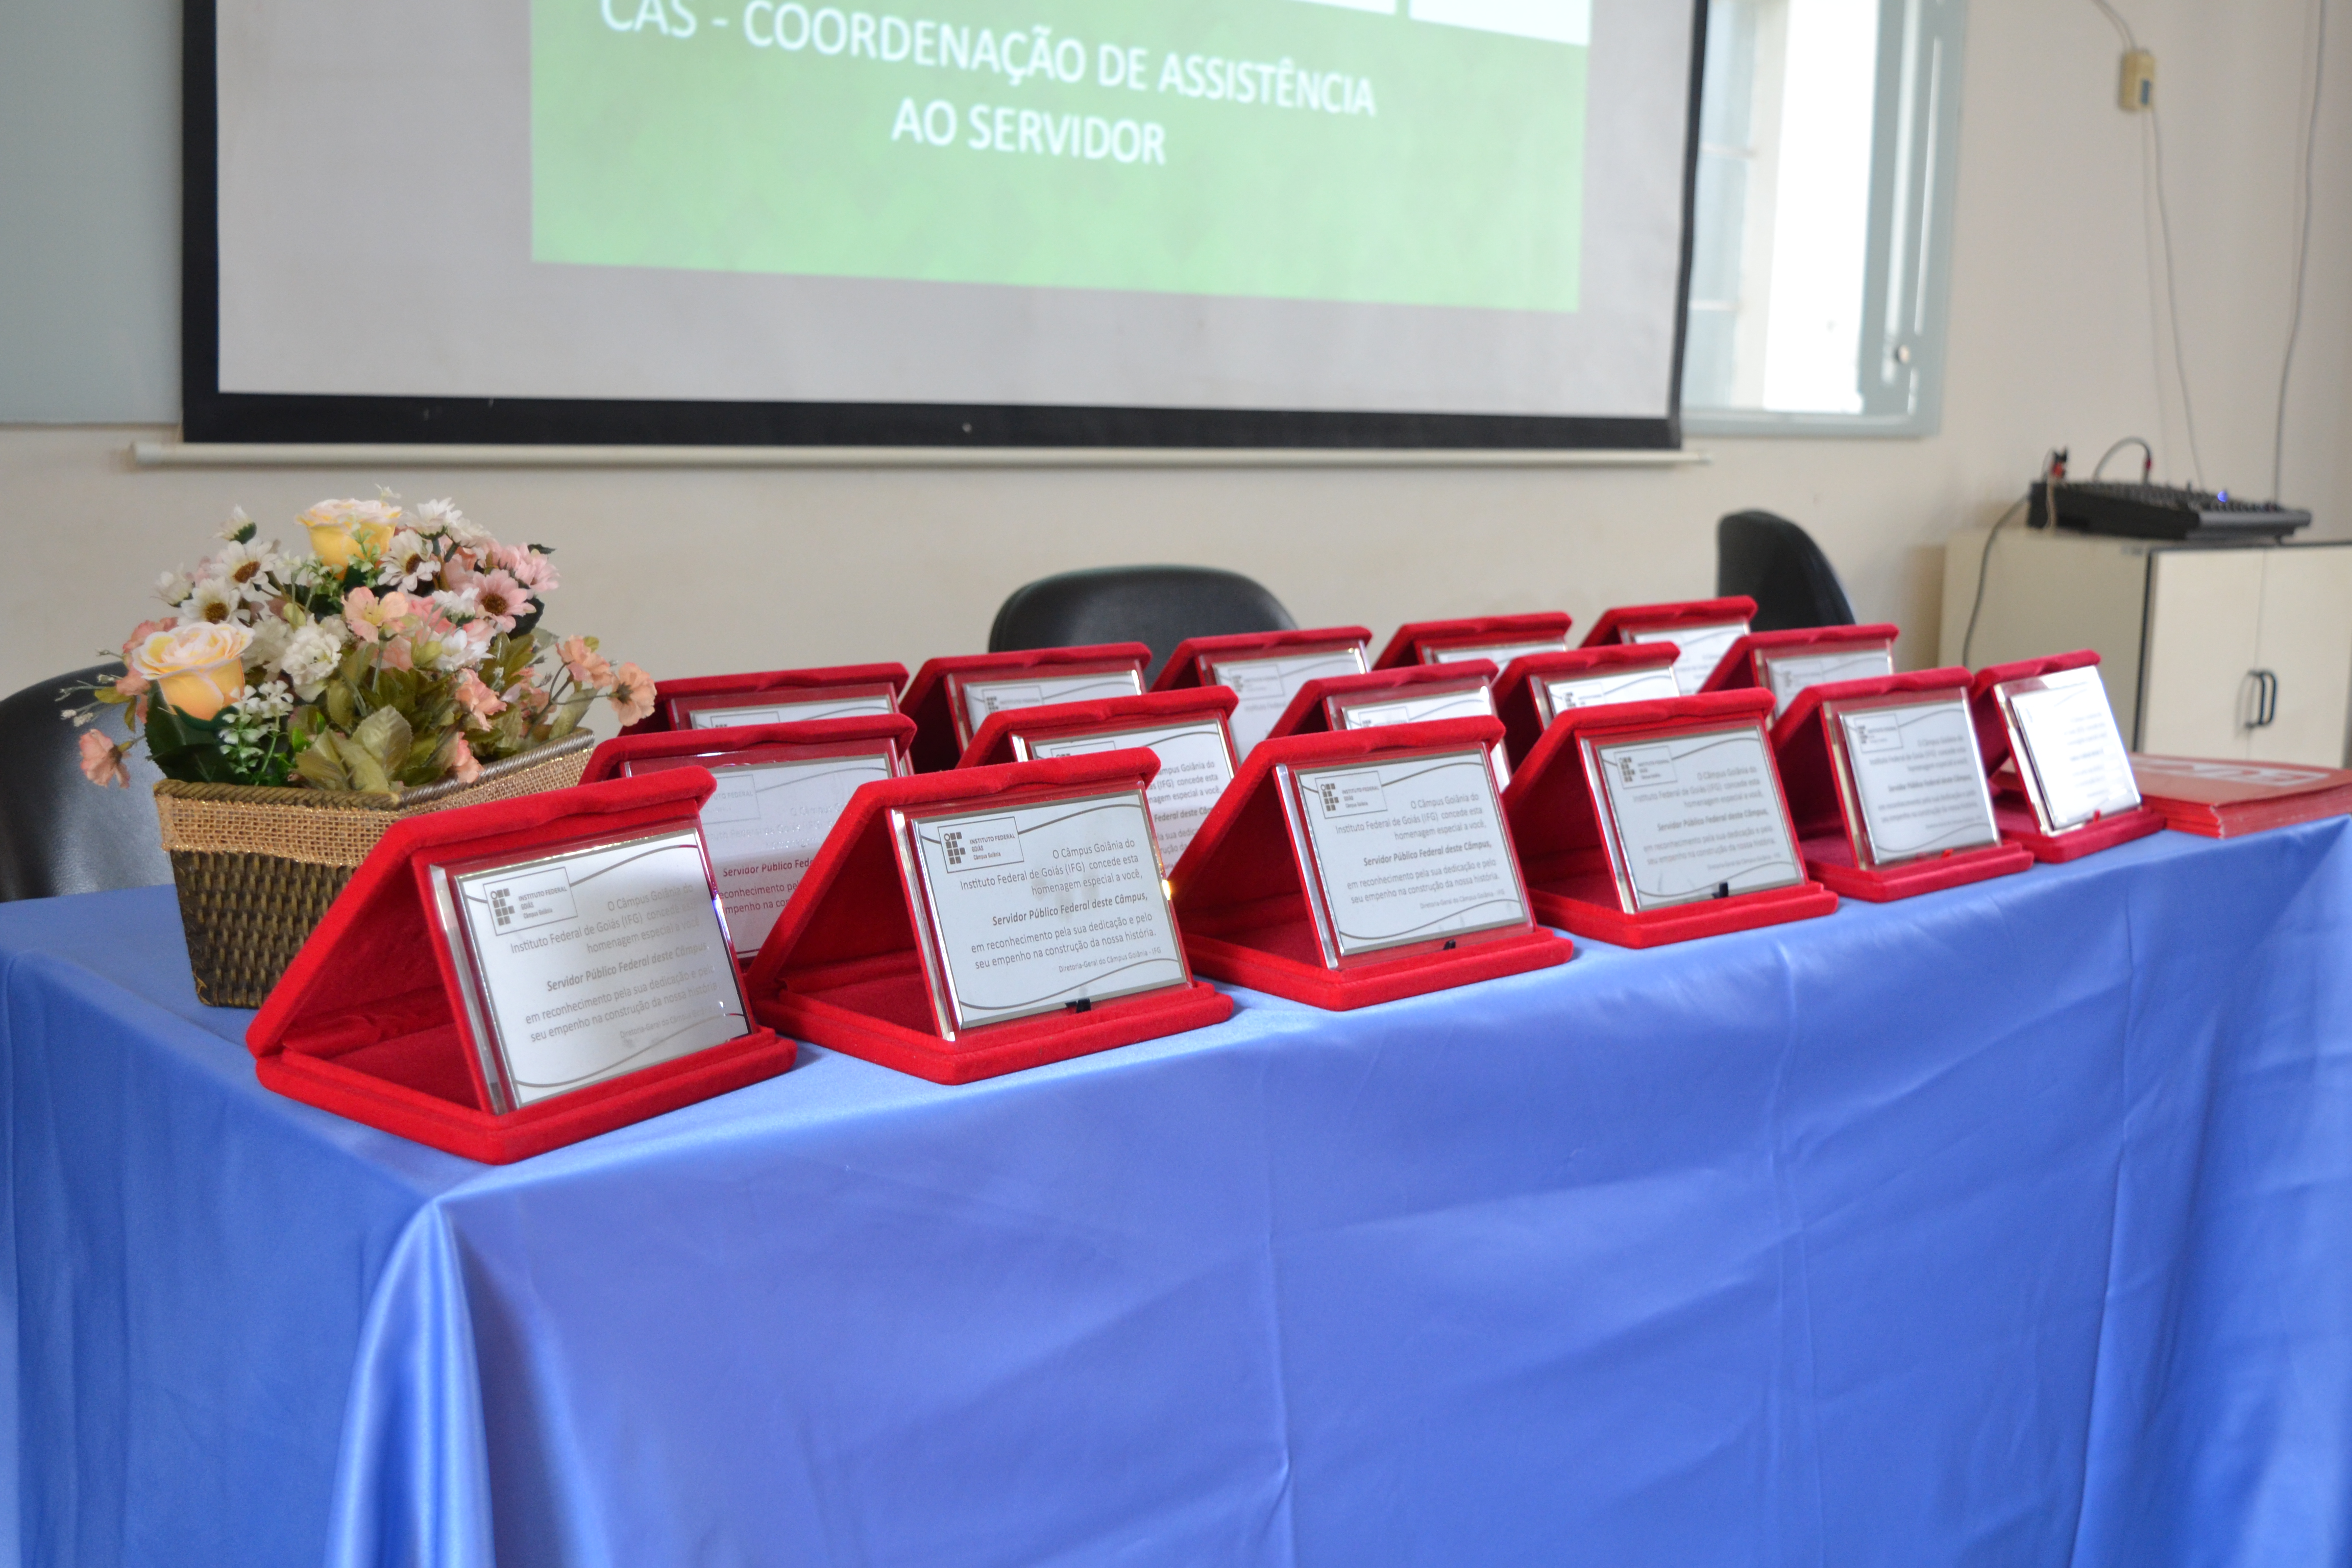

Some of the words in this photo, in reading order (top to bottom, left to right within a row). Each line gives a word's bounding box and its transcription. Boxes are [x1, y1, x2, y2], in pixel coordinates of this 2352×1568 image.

[600, 0, 698, 38] CAS
[712, 17, 729, 27] -
[743, 0, 1086, 86] COORDENAÇÃO
[1097, 44, 1148, 91] DE
[1158, 53, 1376, 117] ASSISTÊNCIA
[891, 97, 957, 145] AO
[967, 104, 1166, 165] SERVIDOR
[1157, 779, 1174, 791] (IFG)
[1177, 775, 1204, 786] concede
[1172, 790, 1198, 801] especial
[1417, 798, 1444, 808] Câmpus
[1444, 793, 1469, 805] Goiânia
[1469, 792, 1479, 801] do
[1154, 812, 1179, 823] Federal
[1180, 808, 1198, 820] deste
[1335, 823, 1365, 834] Instituto
[1365, 817, 1391, 830] Federal
[1391, 817, 1401, 826] de
[1401, 814, 1421, 825] Goiás
[1420, 811, 1438, 824] (IFG)
[1440, 807, 1468, 820] concede
[1468, 806, 1483, 816] esta
[1393, 828, 1436, 841] homenagem
[1436, 822, 1463, 835] especial
[1468, 818, 1486, 829] você,
[969, 836, 994, 844] INSTITUTO
[994, 832, 1016, 841] FEDERAL
[1060, 846, 1093, 858] Câmpus
[1093, 840, 1123, 853] Goiânia
[1124, 838, 1135, 848] do
[1363, 854, 1392, 867] Servidor
[1393, 850, 1418, 862] Público
[1418, 845, 1444, 858] Federal
[1444, 844, 1463, 854] deste
[1463, 840, 1491, 851] Câmpus,
[959, 877, 996, 890] Instituto
[996, 870, 1027, 885] Federal
[1028, 868, 1040, 879] de
[1040, 864, 1064, 877] Goiás
[1064, 861, 1085, 875] (IFG)
[1088, 855, 1121, 870] concede
[1122, 854, 1139, 865] esta
[1031, 880, 1082, 896] homenagem
[1082, 872, 1114, 888] especial
[1121, 868, 1142, 880] você,
[1346, 881, 1359, 890] em
[1359, 872, 1414, 888] reconhecimento
[1414, 868, 1430, 880] pela
[1430, 867, 1442, 876] sua
[1442, 861, 1476, 874] dedicação
[1481, 857, 1497, 869] pelo
[518, 890, 545, 901] INSTITUTO
[544, 885, 568, 896] FEDERAL
[616, 894, 650, 910] Câmpus
[650, 885, 682, 901] Goiânia
[719, 883, 785, 899] econhecimento
[1350, 895, 1364, 904] seu
[1364, 888, 1397, 902] empenho
[1398, 888, 1407, 896] na
[1407, 880, 1444, 894] construção
[1444, 878, 1454, 888] da
[1454, 876, 1474, 887] nossa
[1473, 871, 1500, 884] história.
[725, 903, 761, 915] mpenho
[992, 911, 1027, 926] Servidor
[1028, 906, 1059, 920] Público
[1060, 899, 1090, 914] Federal
[1091, 897, 1113, 909] deste
[1114, 892, 1148, 904] Câmpus,
[509, 937, 548, 954] Instituto
[549, 926, 582, 944] Federal
[583, 924, 595, 936] de
[596, 917, 621, 933] Goiás
[621, 911, 643, 929] (IFG)
[586, 933, 640, 954] homenagem
[641, 922, 674, 941] especial
[970, 943, 985, 953] em
[986, 931, 1053, 950] reconhecimento
[1054, 926, 1072, 940] pela
[1072, 925, 1087, 935] sua
[1088, 916, 1128, 932] dedicação
[1135, 911, 1153, 924] pelo
[974, 959, 990, 969] seu
[991, 950, 1031, 966] empenho
[1032, 949, 1043, 959] na
[1044, 940, 1089, 956] construção
[1089, 937, 1100, 948] da
[1101, 934, 1124, 945] nossa
[1124, 927, 1156, 941] história.
[1058, 958, 1098, 973] Diretoria-Geral
[1106, 953, 1128, 964] Câmpus
[1128, 949, 1148, 960] Goiânia
[1151, 946, 1162, 955] IFG
[546, 973, 584, 992] Servidor
[585, 965, 617, 982] Público
[618, 953, 650, 973] Federal
[651, 950, 673, 964] deste
[525, 1012, 541, 1024] em
[541, 993, 612, 1020] reconhecimento
[613, 986, 632, 1002] pela
[632, 983, 648, 995] sua
[649, 970, 690, 990] dedicação
[530, 1030, 547, 1042] seu
[548, 1017, 590, 1037] empenho
[591, 1014, 603, 1025] na
[604, 999, 650, 1021] construção
[651, 995, 662, 1008] da
[663, 990, 687, 1004] nossa
